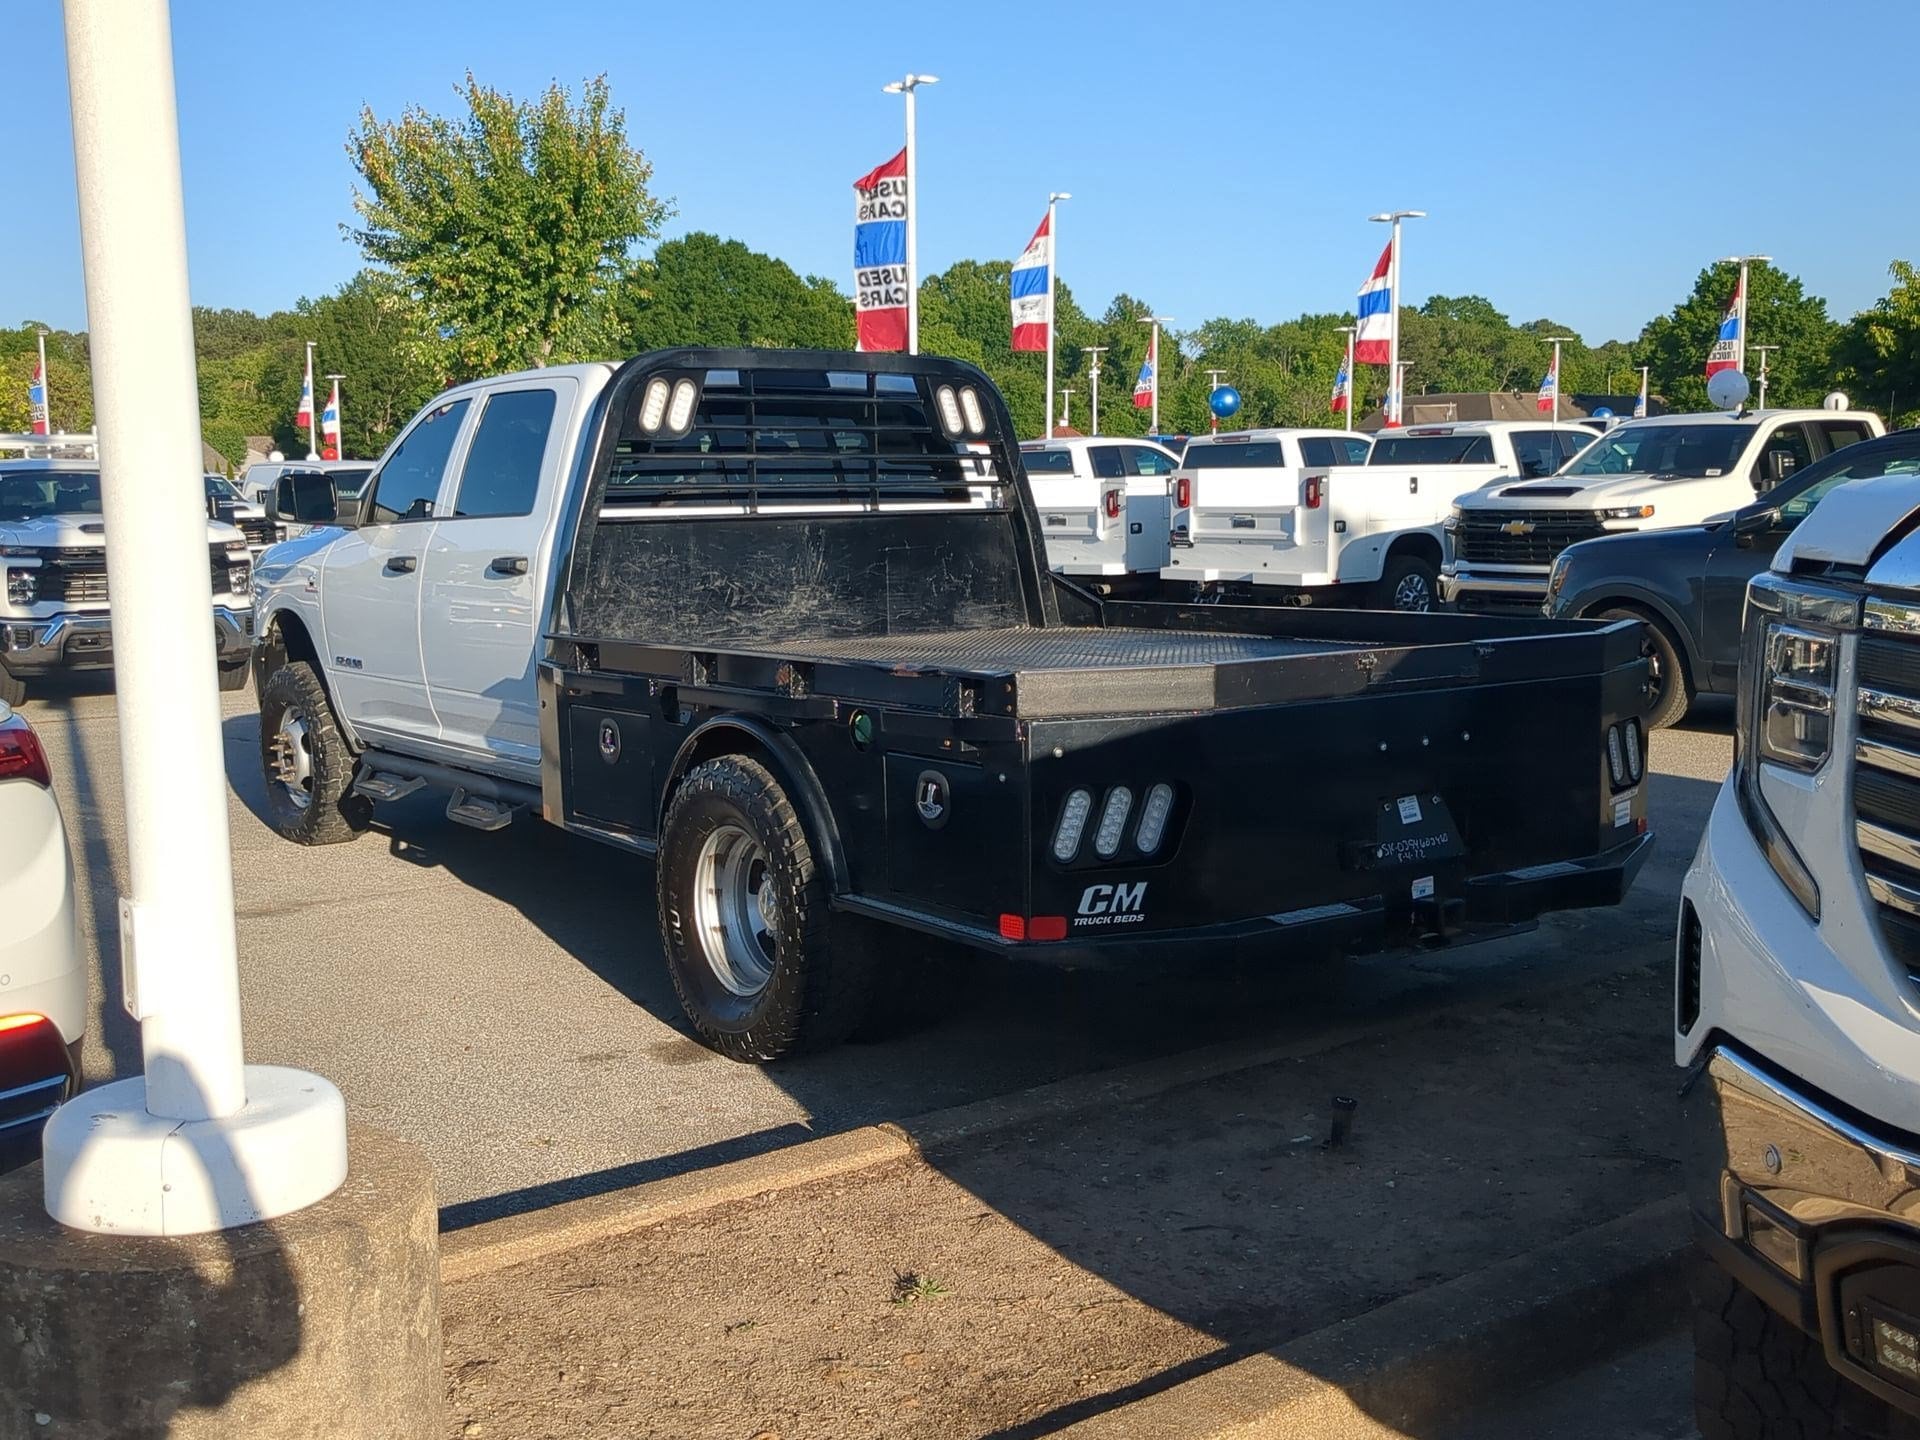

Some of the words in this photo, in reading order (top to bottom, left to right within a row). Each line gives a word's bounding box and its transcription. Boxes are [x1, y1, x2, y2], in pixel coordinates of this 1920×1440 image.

[1077, 881, 1148, 915] CM
[1073, 915, 1112, 927] TRUCK
[1113, 914, 1145, 924] BEDS
